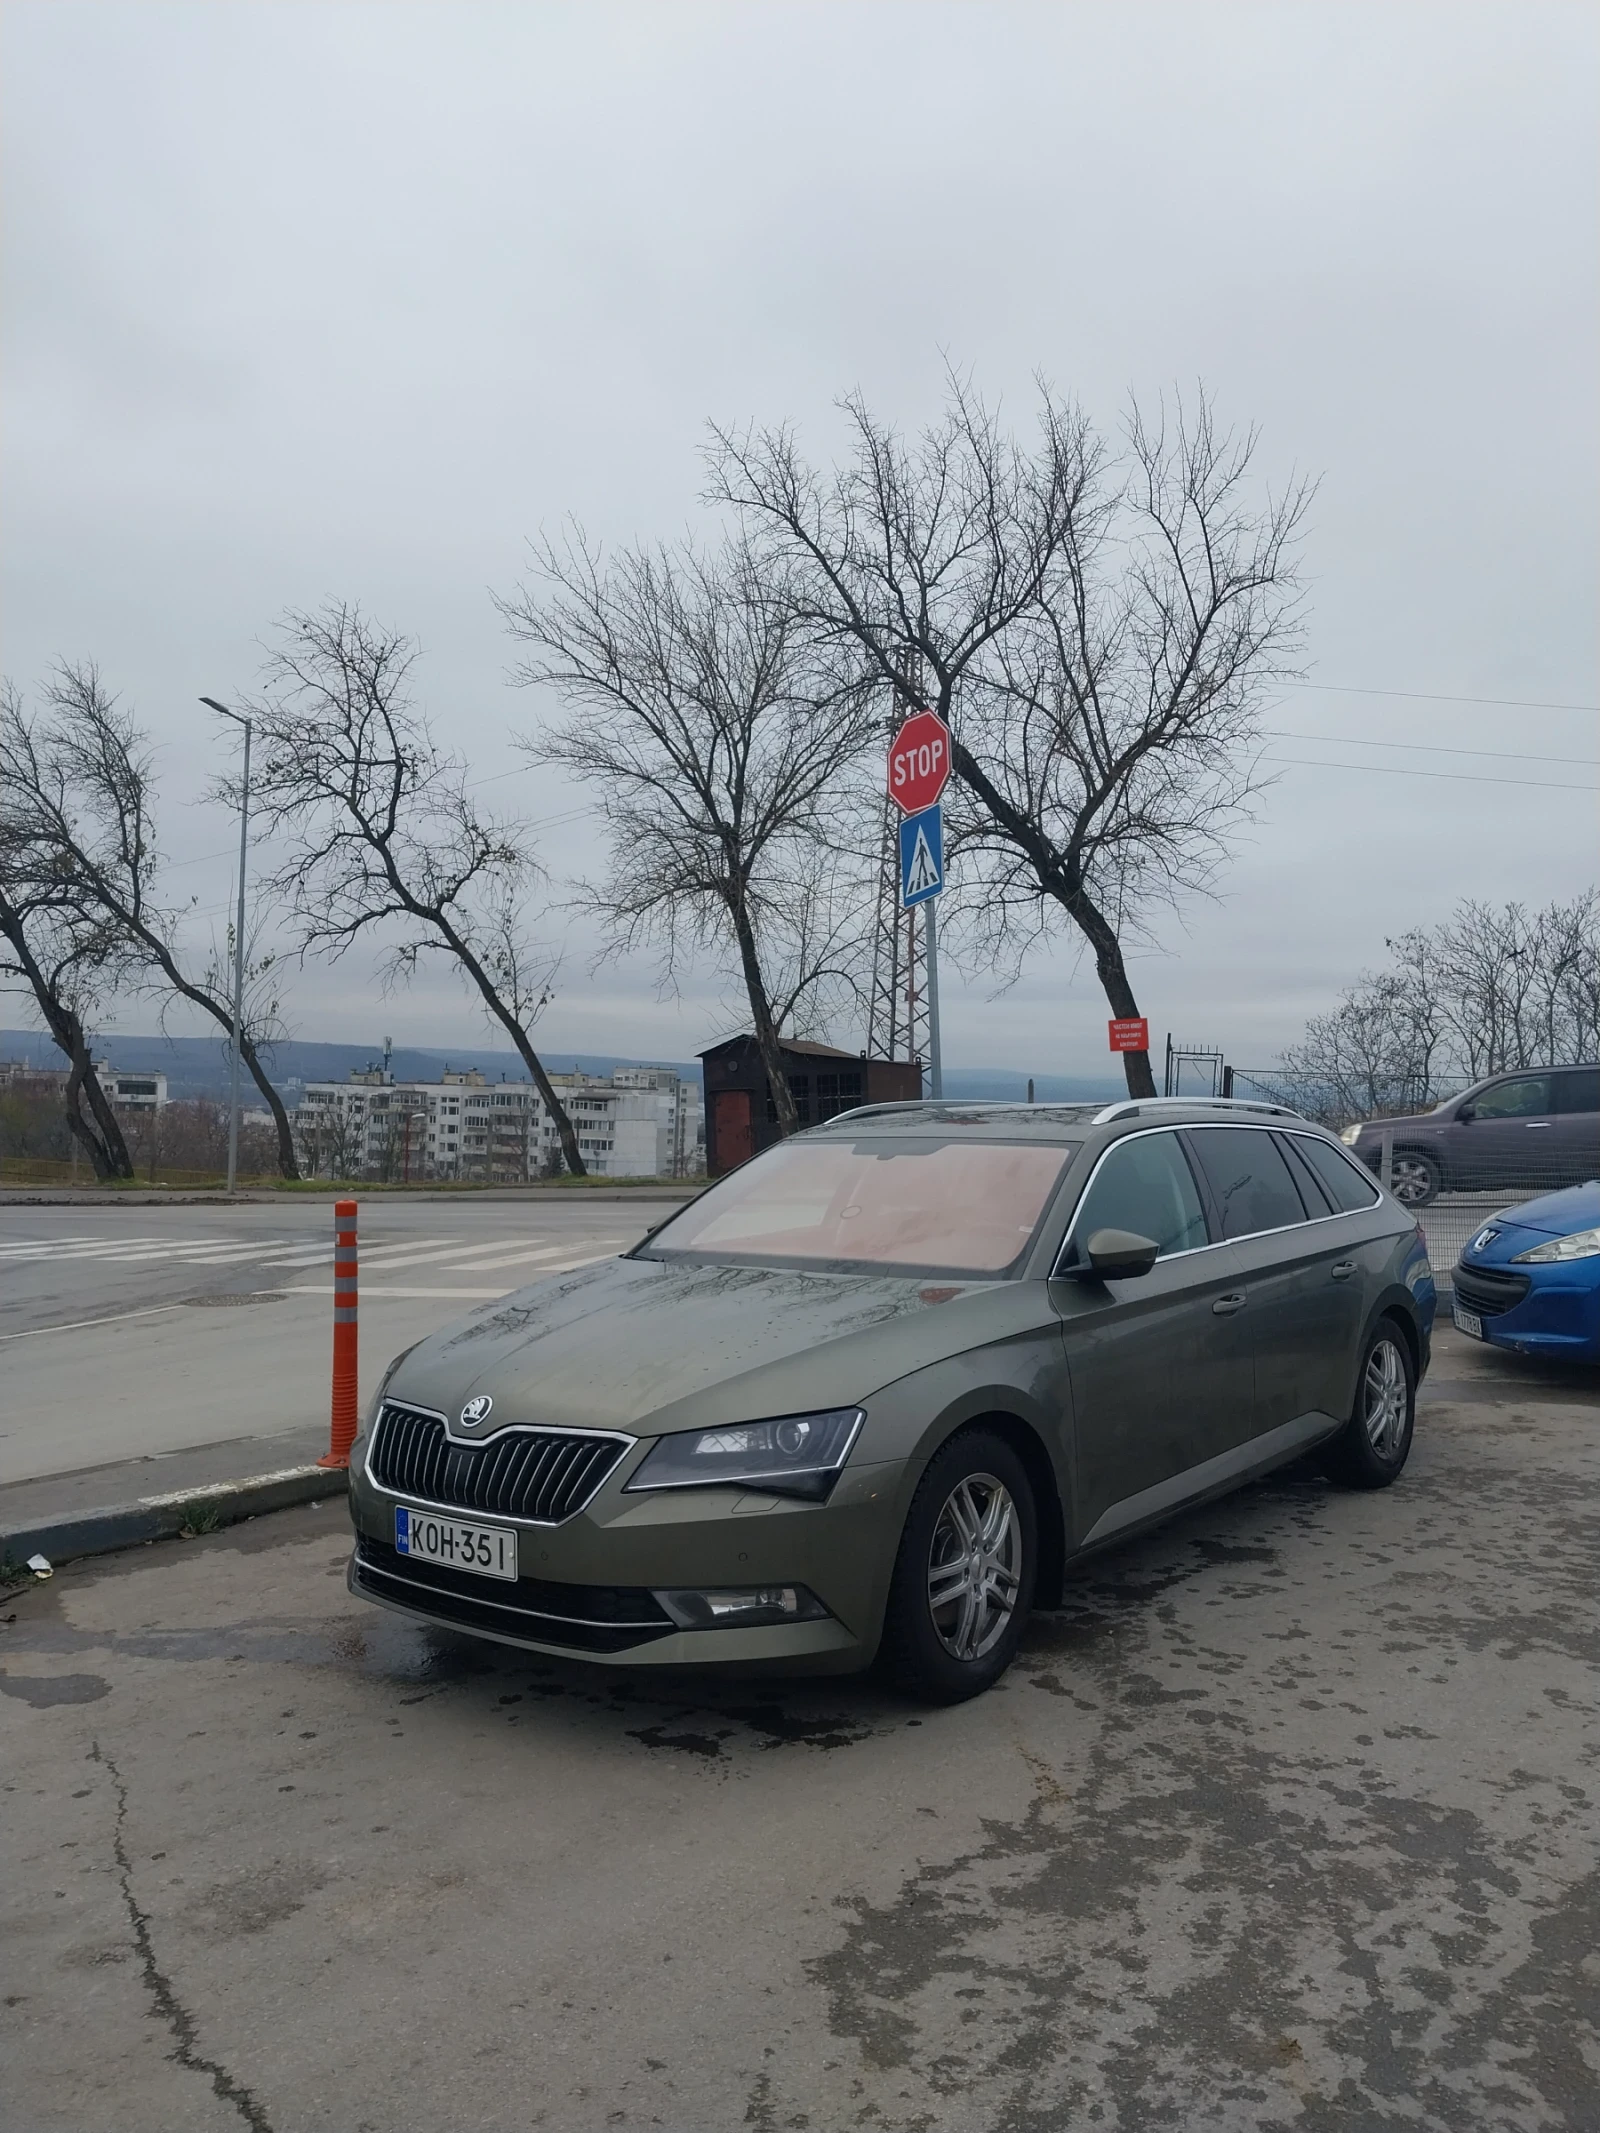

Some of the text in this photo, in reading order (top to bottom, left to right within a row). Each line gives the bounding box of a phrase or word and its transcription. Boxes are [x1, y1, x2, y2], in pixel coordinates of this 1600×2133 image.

[894, 739, 943, 786] STOP
[398, 1534, 408, 1545] FIN
[412, 1518, 504, 1570] KOH-351
